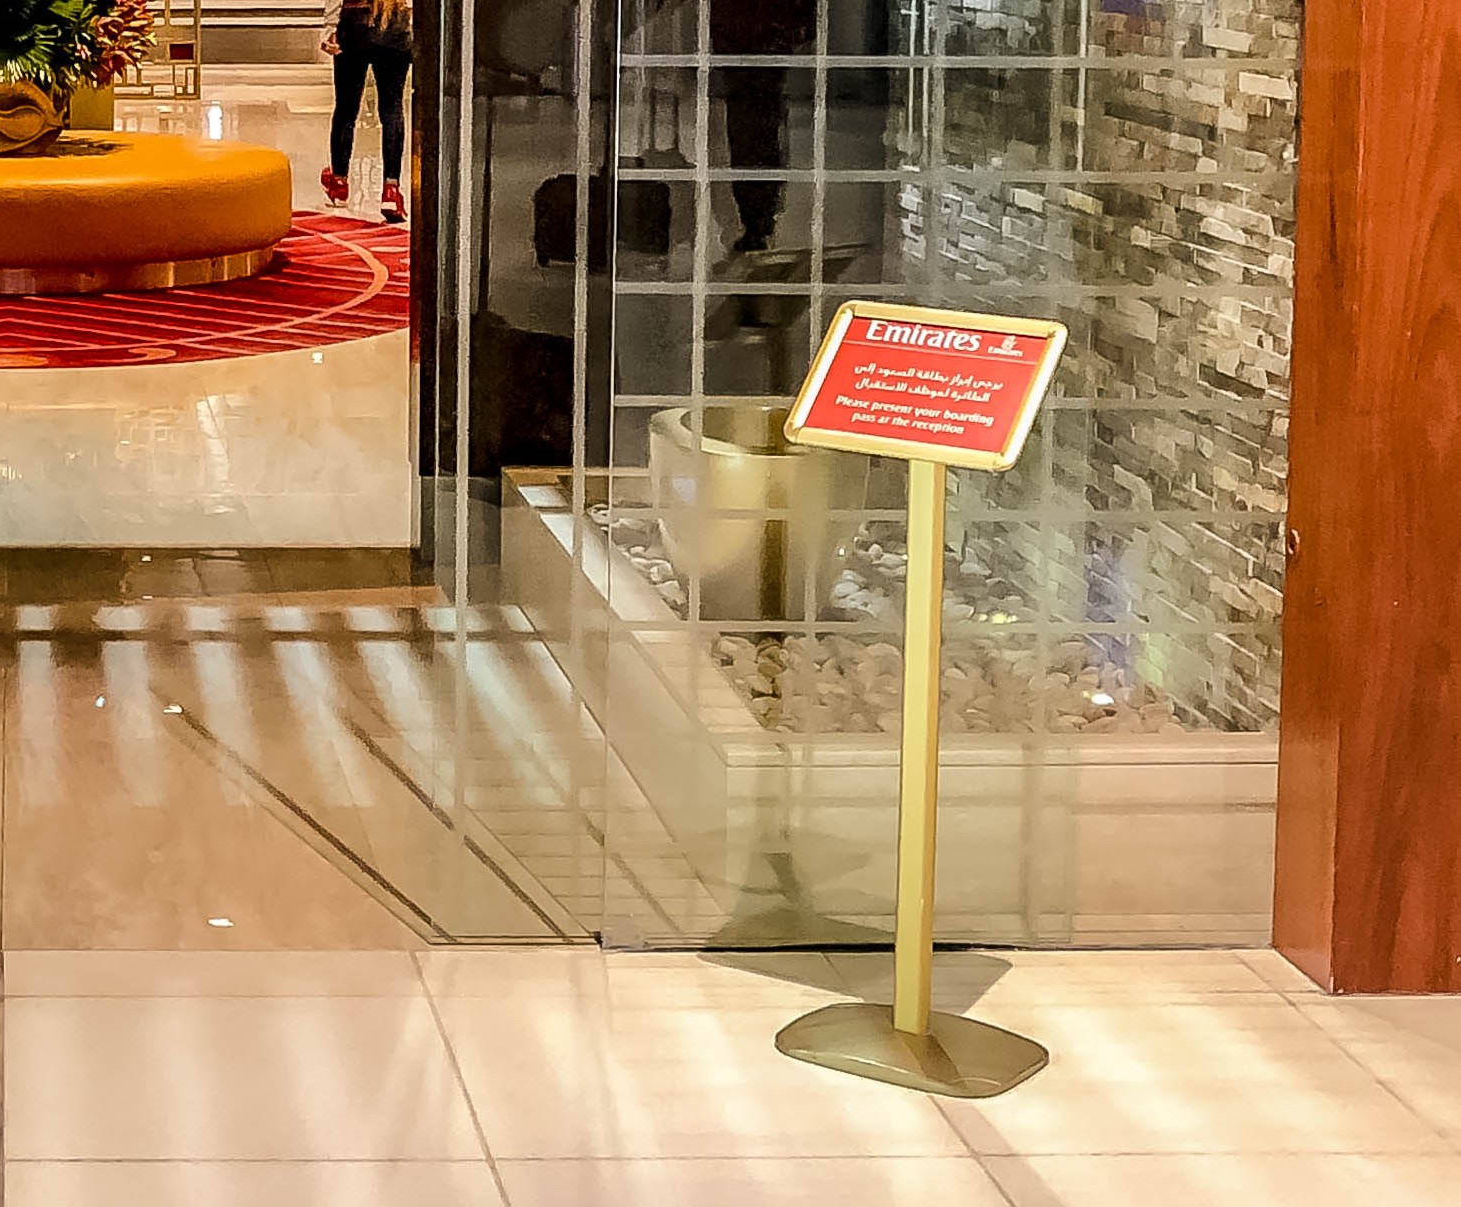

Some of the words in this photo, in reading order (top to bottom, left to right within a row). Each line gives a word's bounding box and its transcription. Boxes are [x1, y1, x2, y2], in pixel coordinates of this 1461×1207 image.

[866, 320, 982, 351] Emirates
[854, 363, 876, 374] إلى
[835, 395, 869, 408] Please
[871, 401, 913, 414] present
[914, 407, 941, 417] your
[943, 410, 994, 427] boarding
[851, 412, 875, 423] pass
[877, 415, 890, 424] at
[891, 415, 910, 427] the
[911, 420, 965, 434] reception
